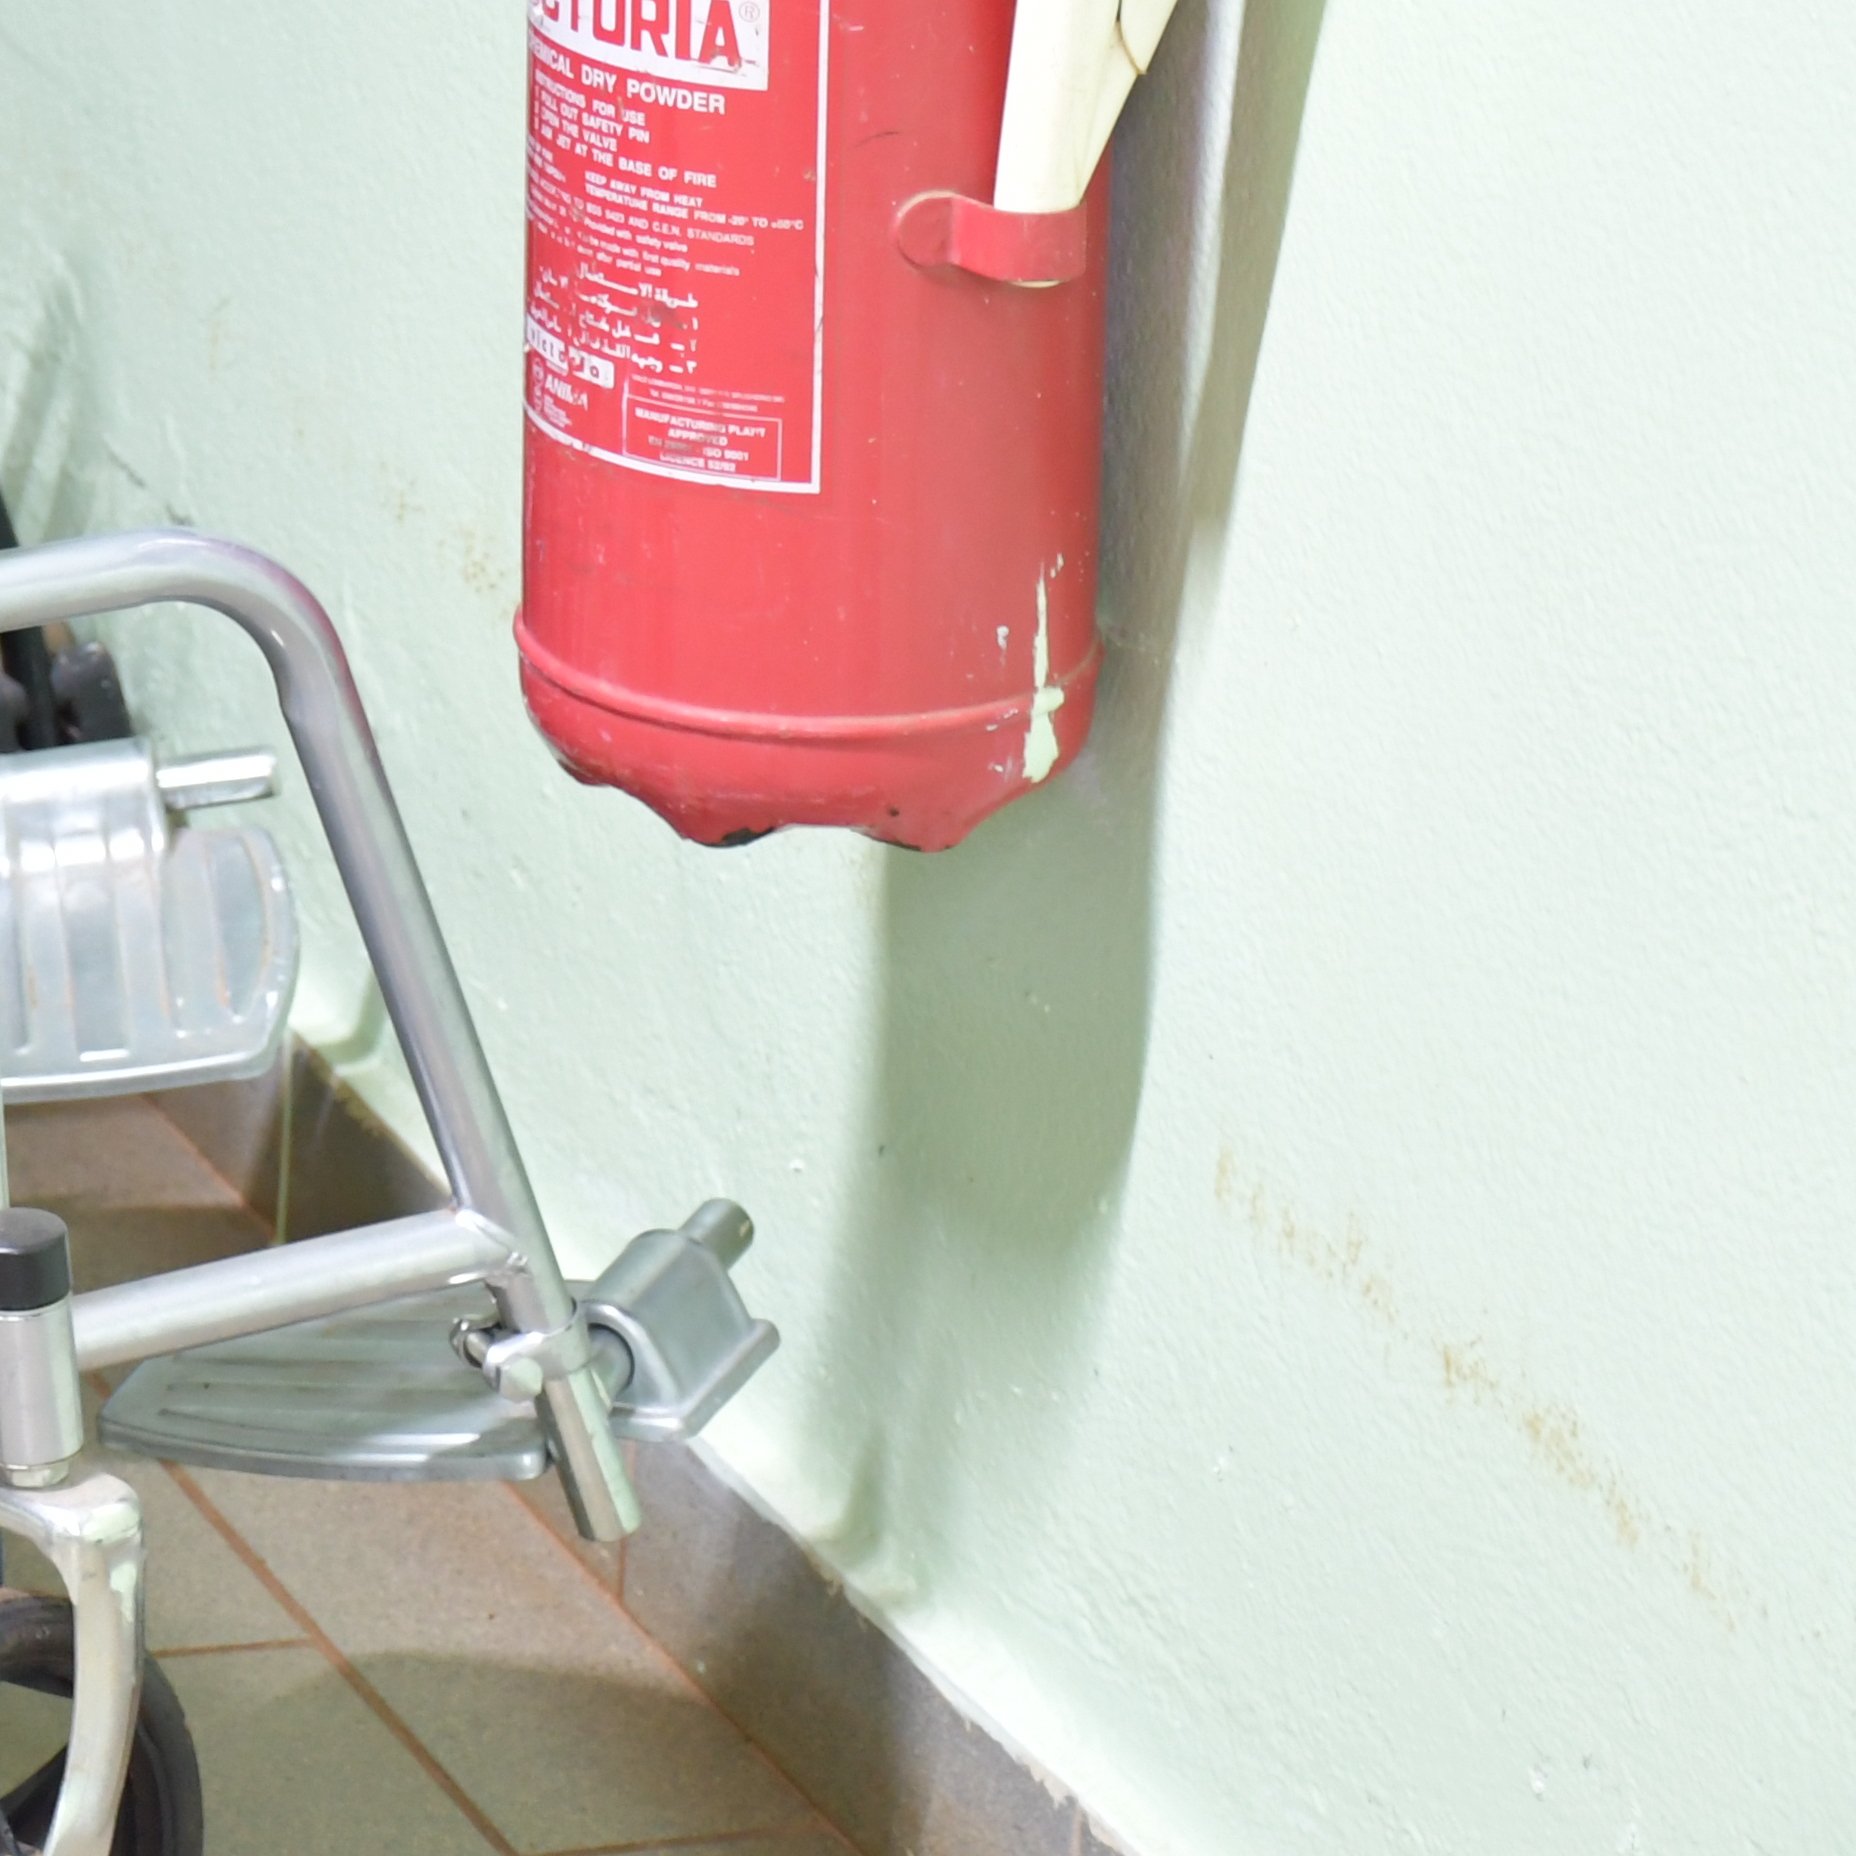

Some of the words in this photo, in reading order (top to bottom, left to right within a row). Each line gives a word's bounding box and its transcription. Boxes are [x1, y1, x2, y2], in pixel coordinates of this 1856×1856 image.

[581, 63, 618, 94] DRY
[626, 77, 726, 115] POWDER
[560, 102, 580, 121] OUT
[581, 112, 624, 137] SAFETY
[628, 126, 651, 144] PIN
[592, 99, 616, 119] FOR
[621, 108, 646, 127] USE
[562, 119, 580, 139] THE
[582, 129, 618, 153] VALVE
[574, 141, 589, 158] AT
[591, 147, 614, 168] THE
[618, 156, 653, 178] BASE
[658, 165, 679, 182] OF
[684, 170, 718, 189] FIRE
[639, 186, 671, 203] FROM
[673, 193, 704, 208] HEAT
[651, 201, 689, 220] RANGE
[693, 209, 727, 225] FROM
[752, 216, 769, 229] TO
[686, 227, 755, 247] STANDARDS
[634, 406, 727, 434] MANUFACTURING
[667, 427, 729, 447] APPROVED
